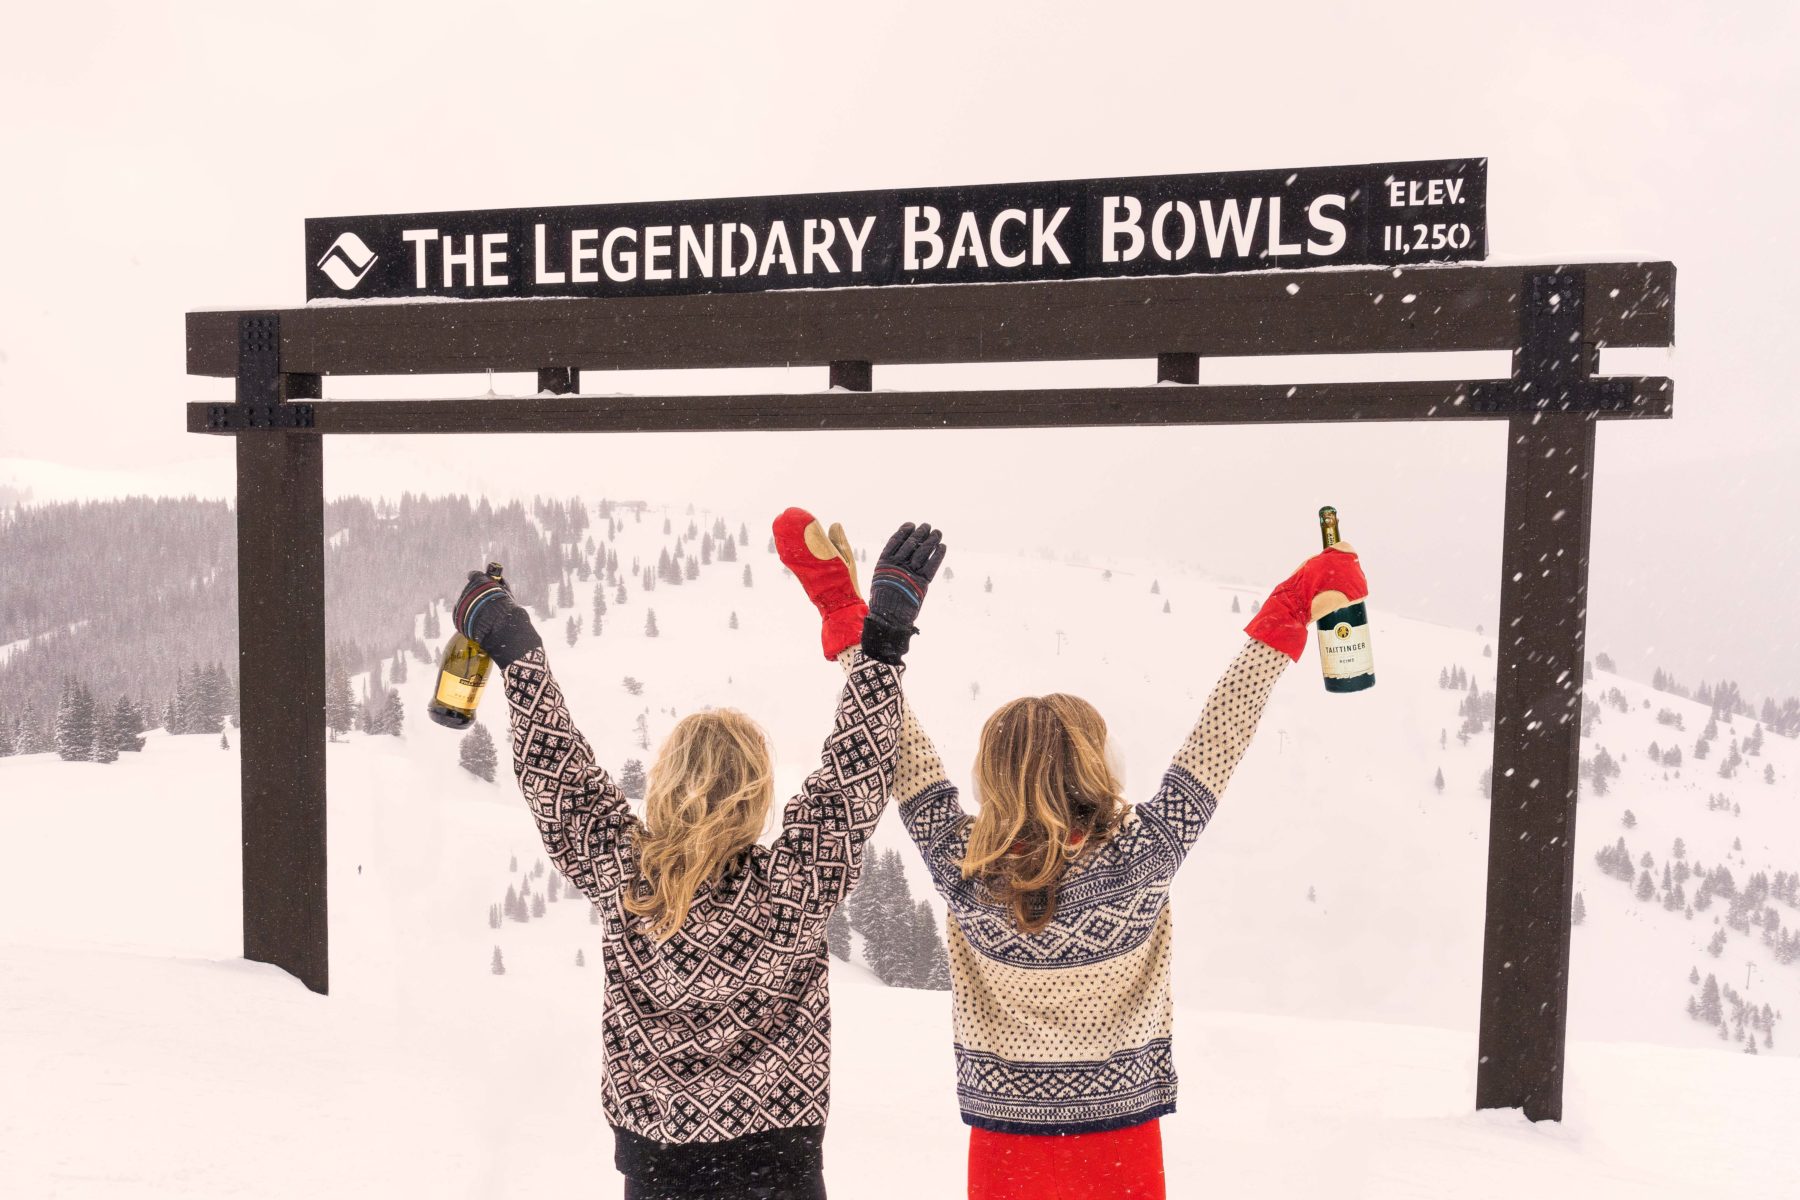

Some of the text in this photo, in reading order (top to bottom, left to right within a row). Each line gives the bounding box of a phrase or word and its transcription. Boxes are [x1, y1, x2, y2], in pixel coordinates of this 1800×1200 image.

[1390, 178, 1466, 207] ELEV.
[402, 194, 1347, 290] THE LEGENDARY BACK BOWLS
[1384, 223, 1471, 255] 11,250
[1325, 642, 1366, 654] TAITTINGER
